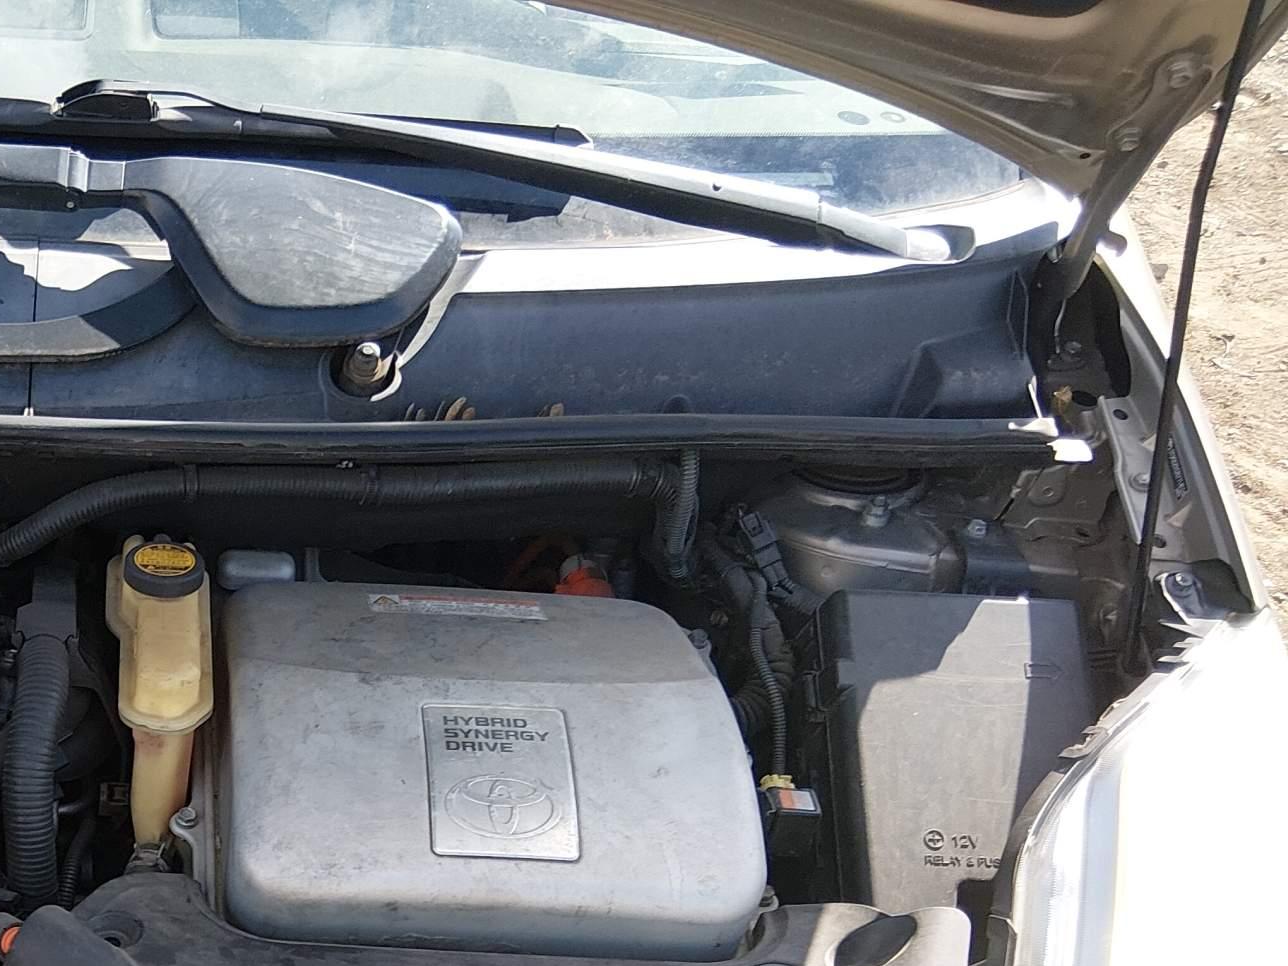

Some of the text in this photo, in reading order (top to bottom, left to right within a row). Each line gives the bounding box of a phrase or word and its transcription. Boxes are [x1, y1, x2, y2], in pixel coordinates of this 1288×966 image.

[443, 715, 528, 729] HYBRID
[444, 728, 549, 742] SYNERGY
[445, 740, 514, 753] DRIVE
[951, 833, 978, 849] 12V
[923, 854, 961, 868] RELAY
